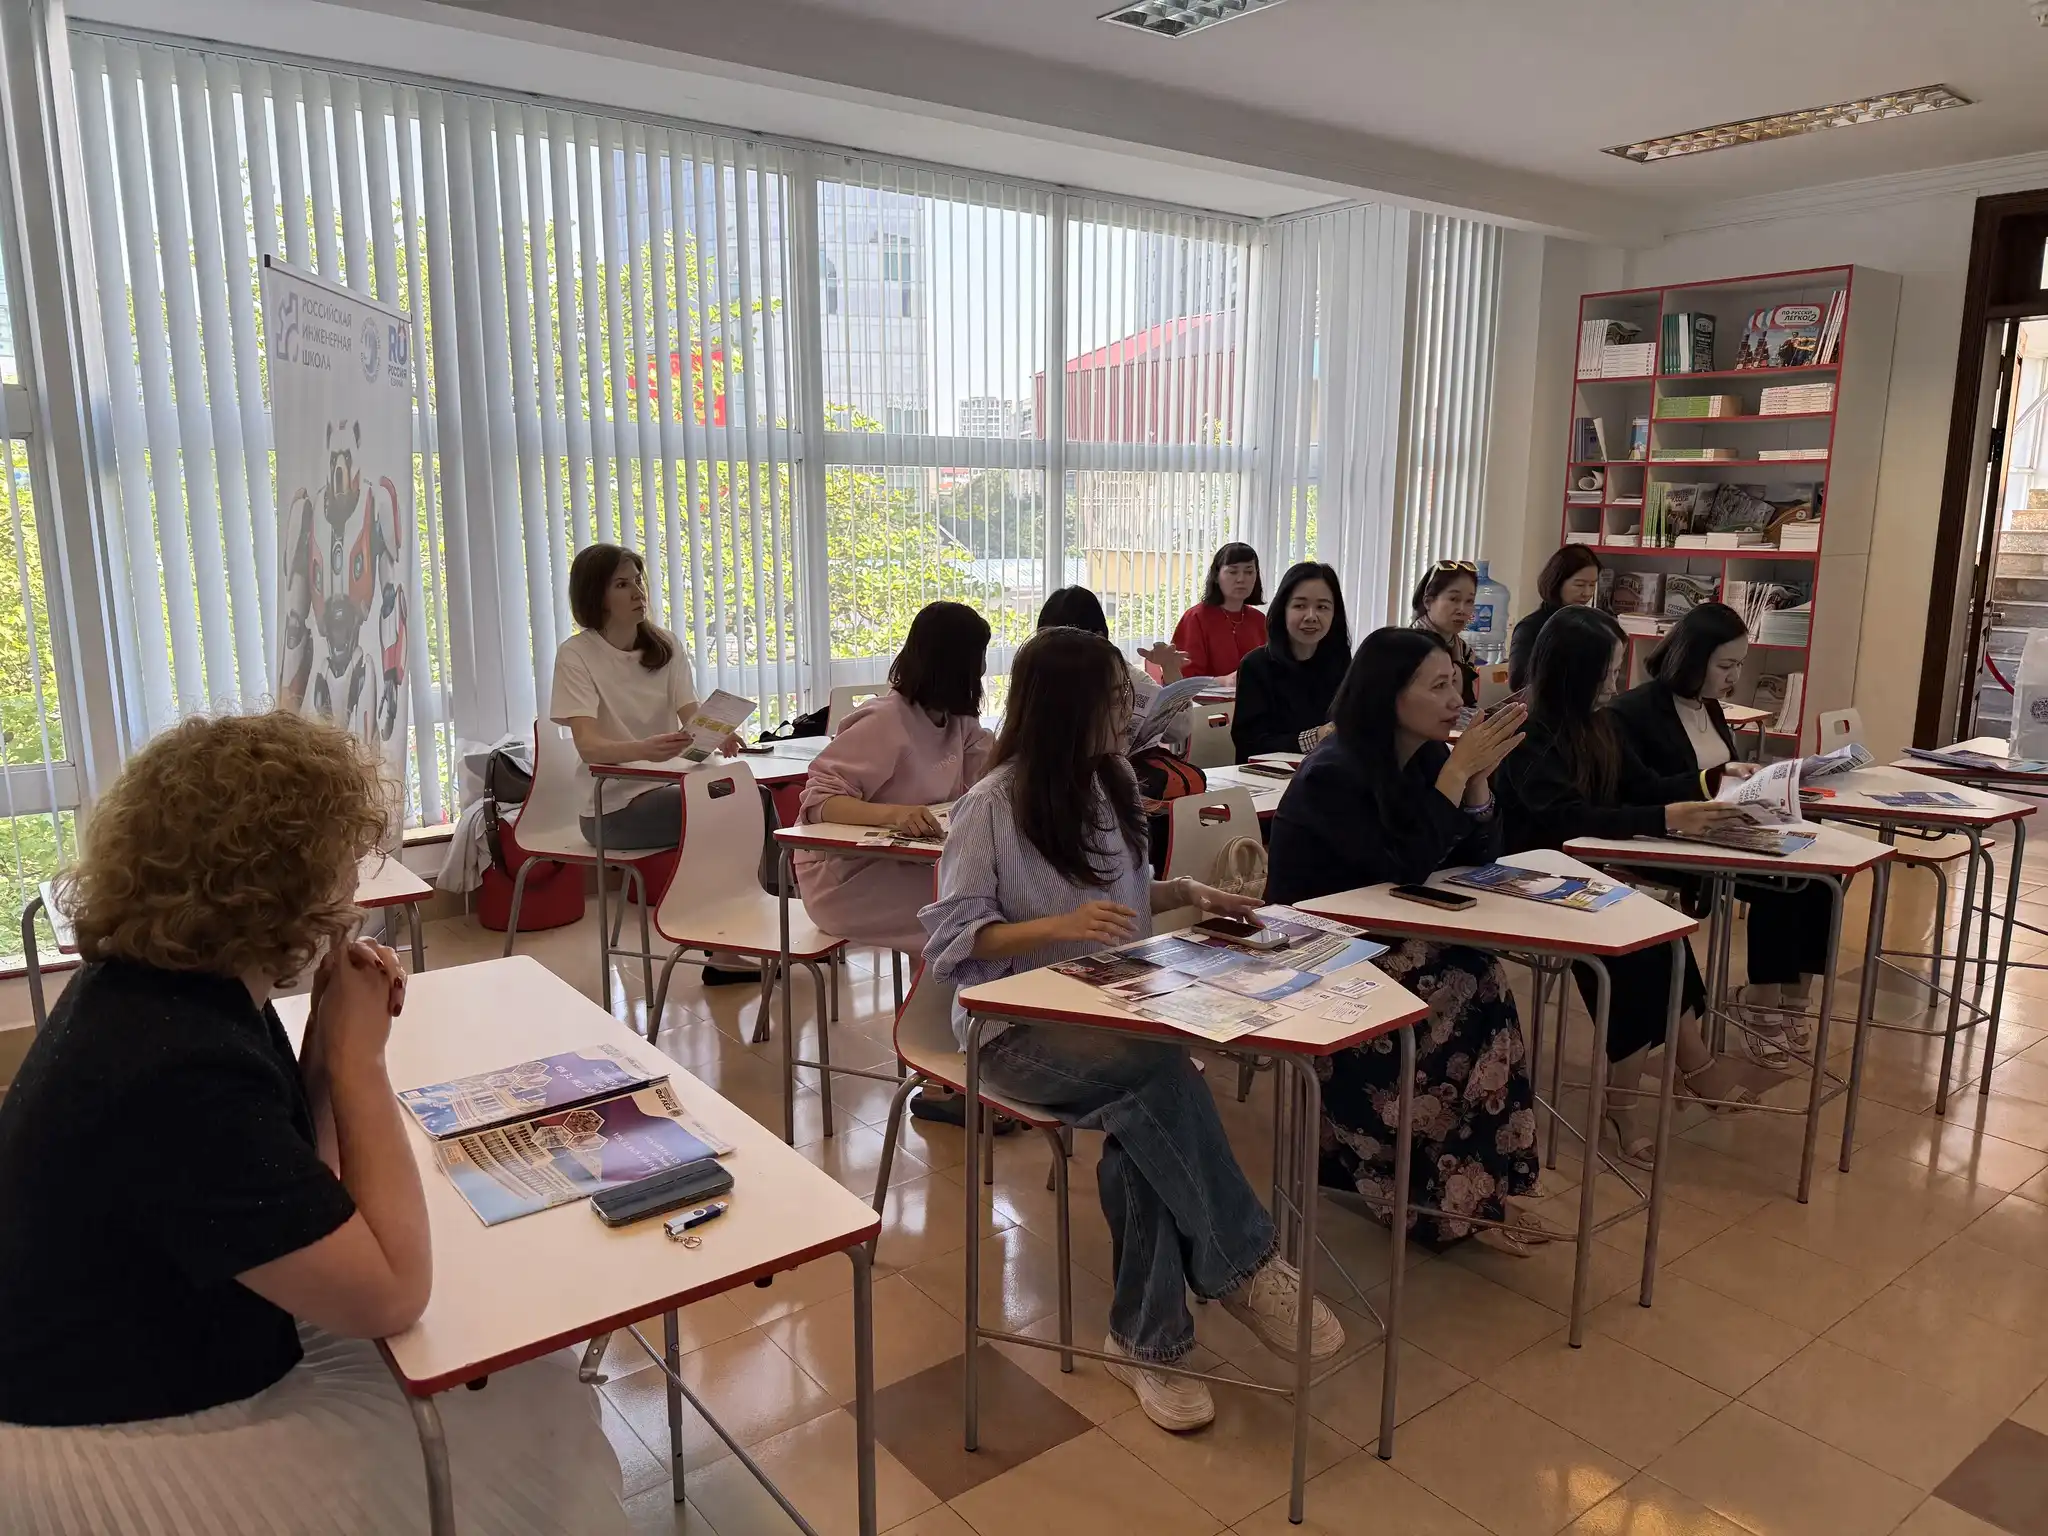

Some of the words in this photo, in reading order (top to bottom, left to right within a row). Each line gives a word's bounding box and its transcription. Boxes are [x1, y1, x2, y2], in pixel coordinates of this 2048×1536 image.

[302, 296, 352, 329] РОССИЙСКАЯ
[302, 323, 352, 354] ИНЖЕНЕРНАЯ
[302, 349, 331, 370] ШКОЛА
